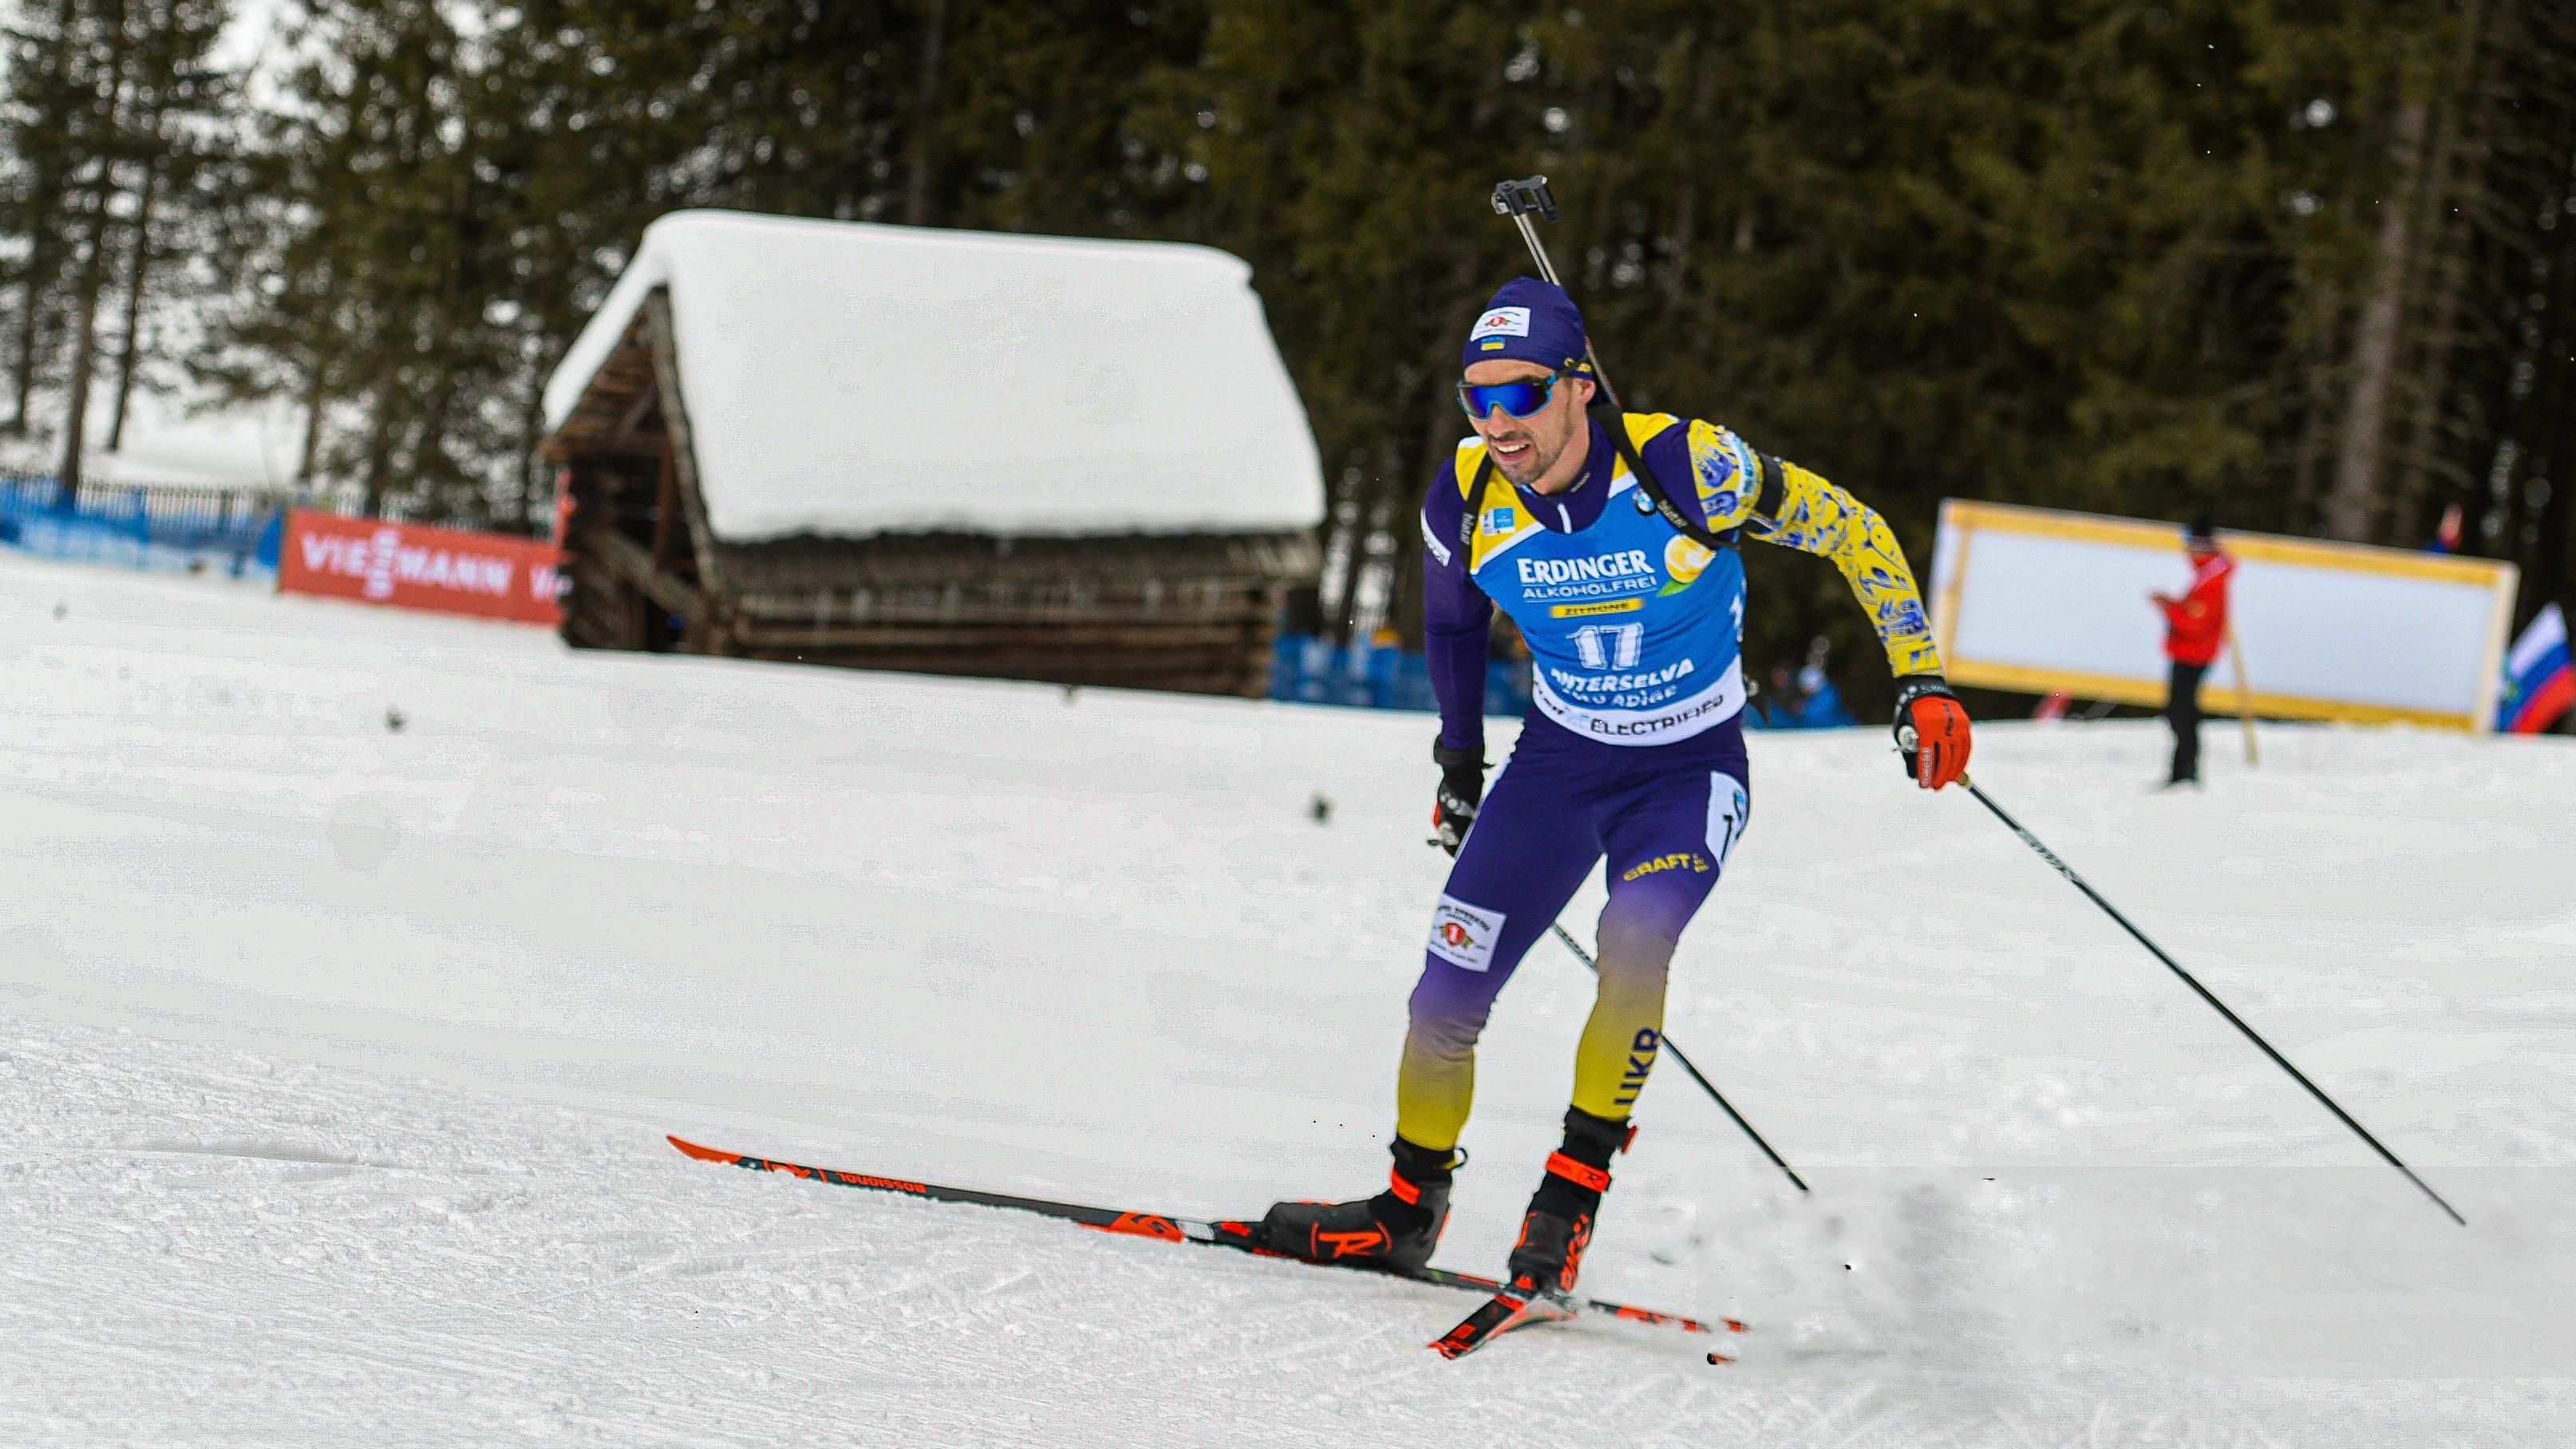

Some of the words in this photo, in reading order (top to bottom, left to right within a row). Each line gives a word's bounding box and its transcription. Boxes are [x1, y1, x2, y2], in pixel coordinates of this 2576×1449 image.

[1516, 549, 1655, 586] ERDINGER
[1522, 576, 1657, 599] ALKOHOLFREI
[1566, 622, 1646, 671] 17
[1590, 693, 1725, 736] ELECTRIFIED
[1622, 852, 1691, 882] CRAFT
